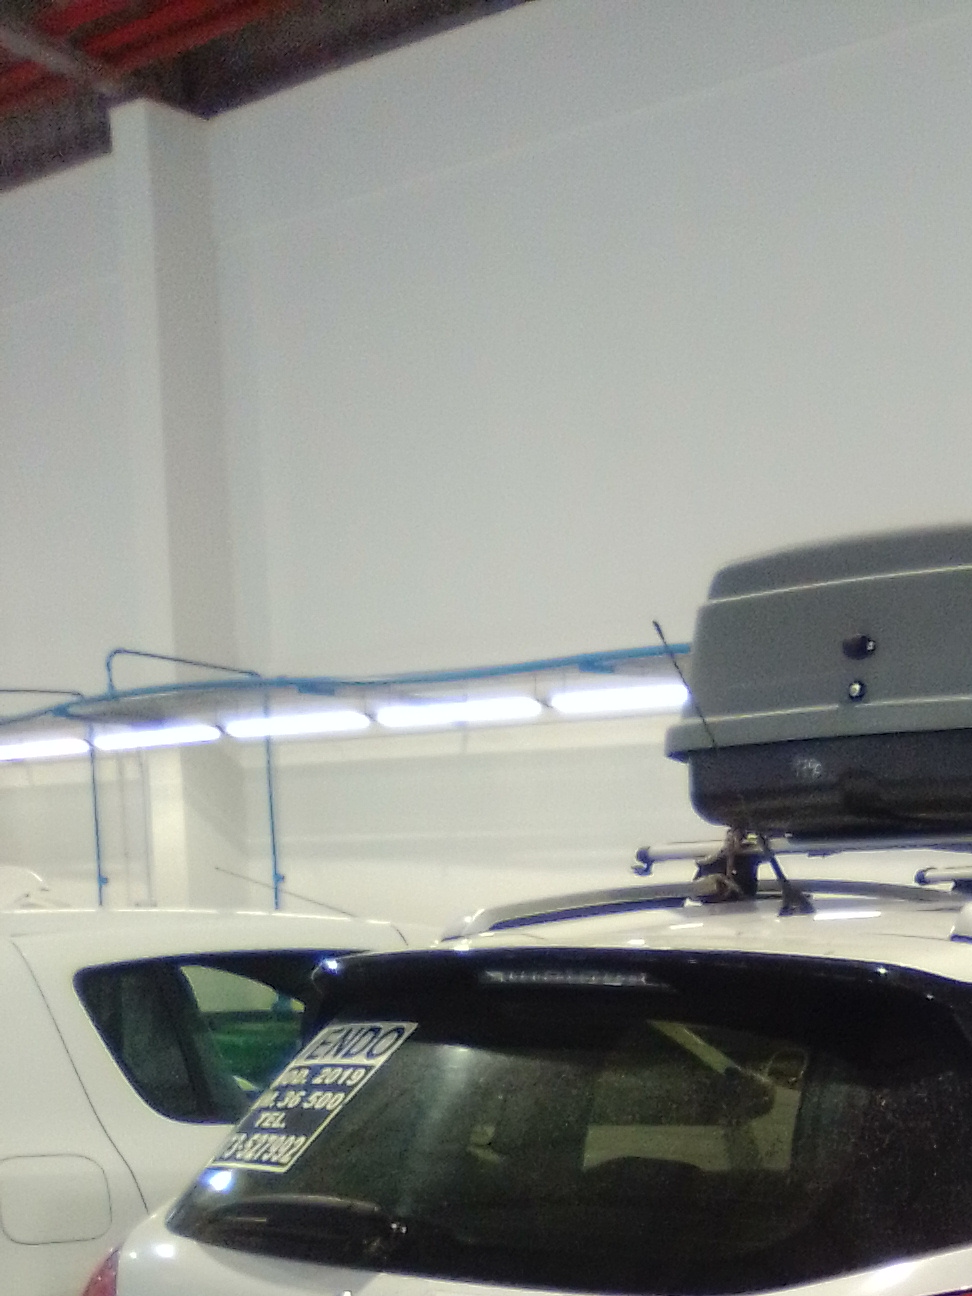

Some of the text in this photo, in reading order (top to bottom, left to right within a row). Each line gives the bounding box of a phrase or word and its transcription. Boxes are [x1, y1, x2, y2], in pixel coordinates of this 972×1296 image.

[302, 1025, 405, 1061] ENDO
[312, 1066, 367, 1087] 2019
[303, 1091, 347, 1110] 500
